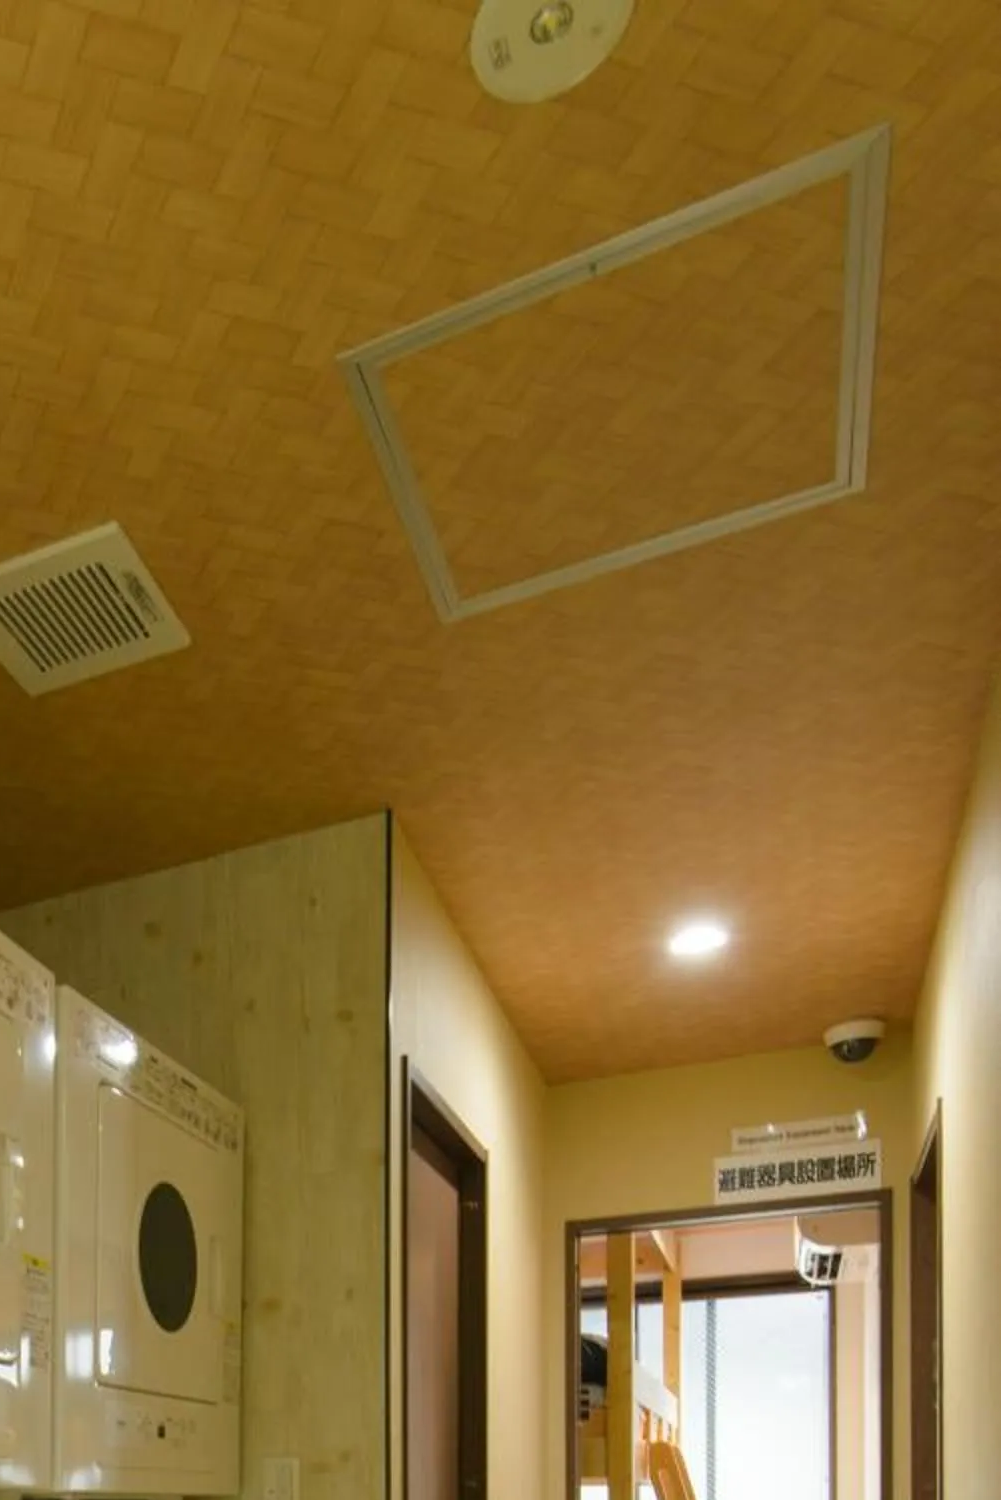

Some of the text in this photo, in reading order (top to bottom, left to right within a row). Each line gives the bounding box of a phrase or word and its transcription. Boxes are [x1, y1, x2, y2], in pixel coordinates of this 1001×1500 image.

[718, 1152, 876, 1192] 避難器具設置場所
